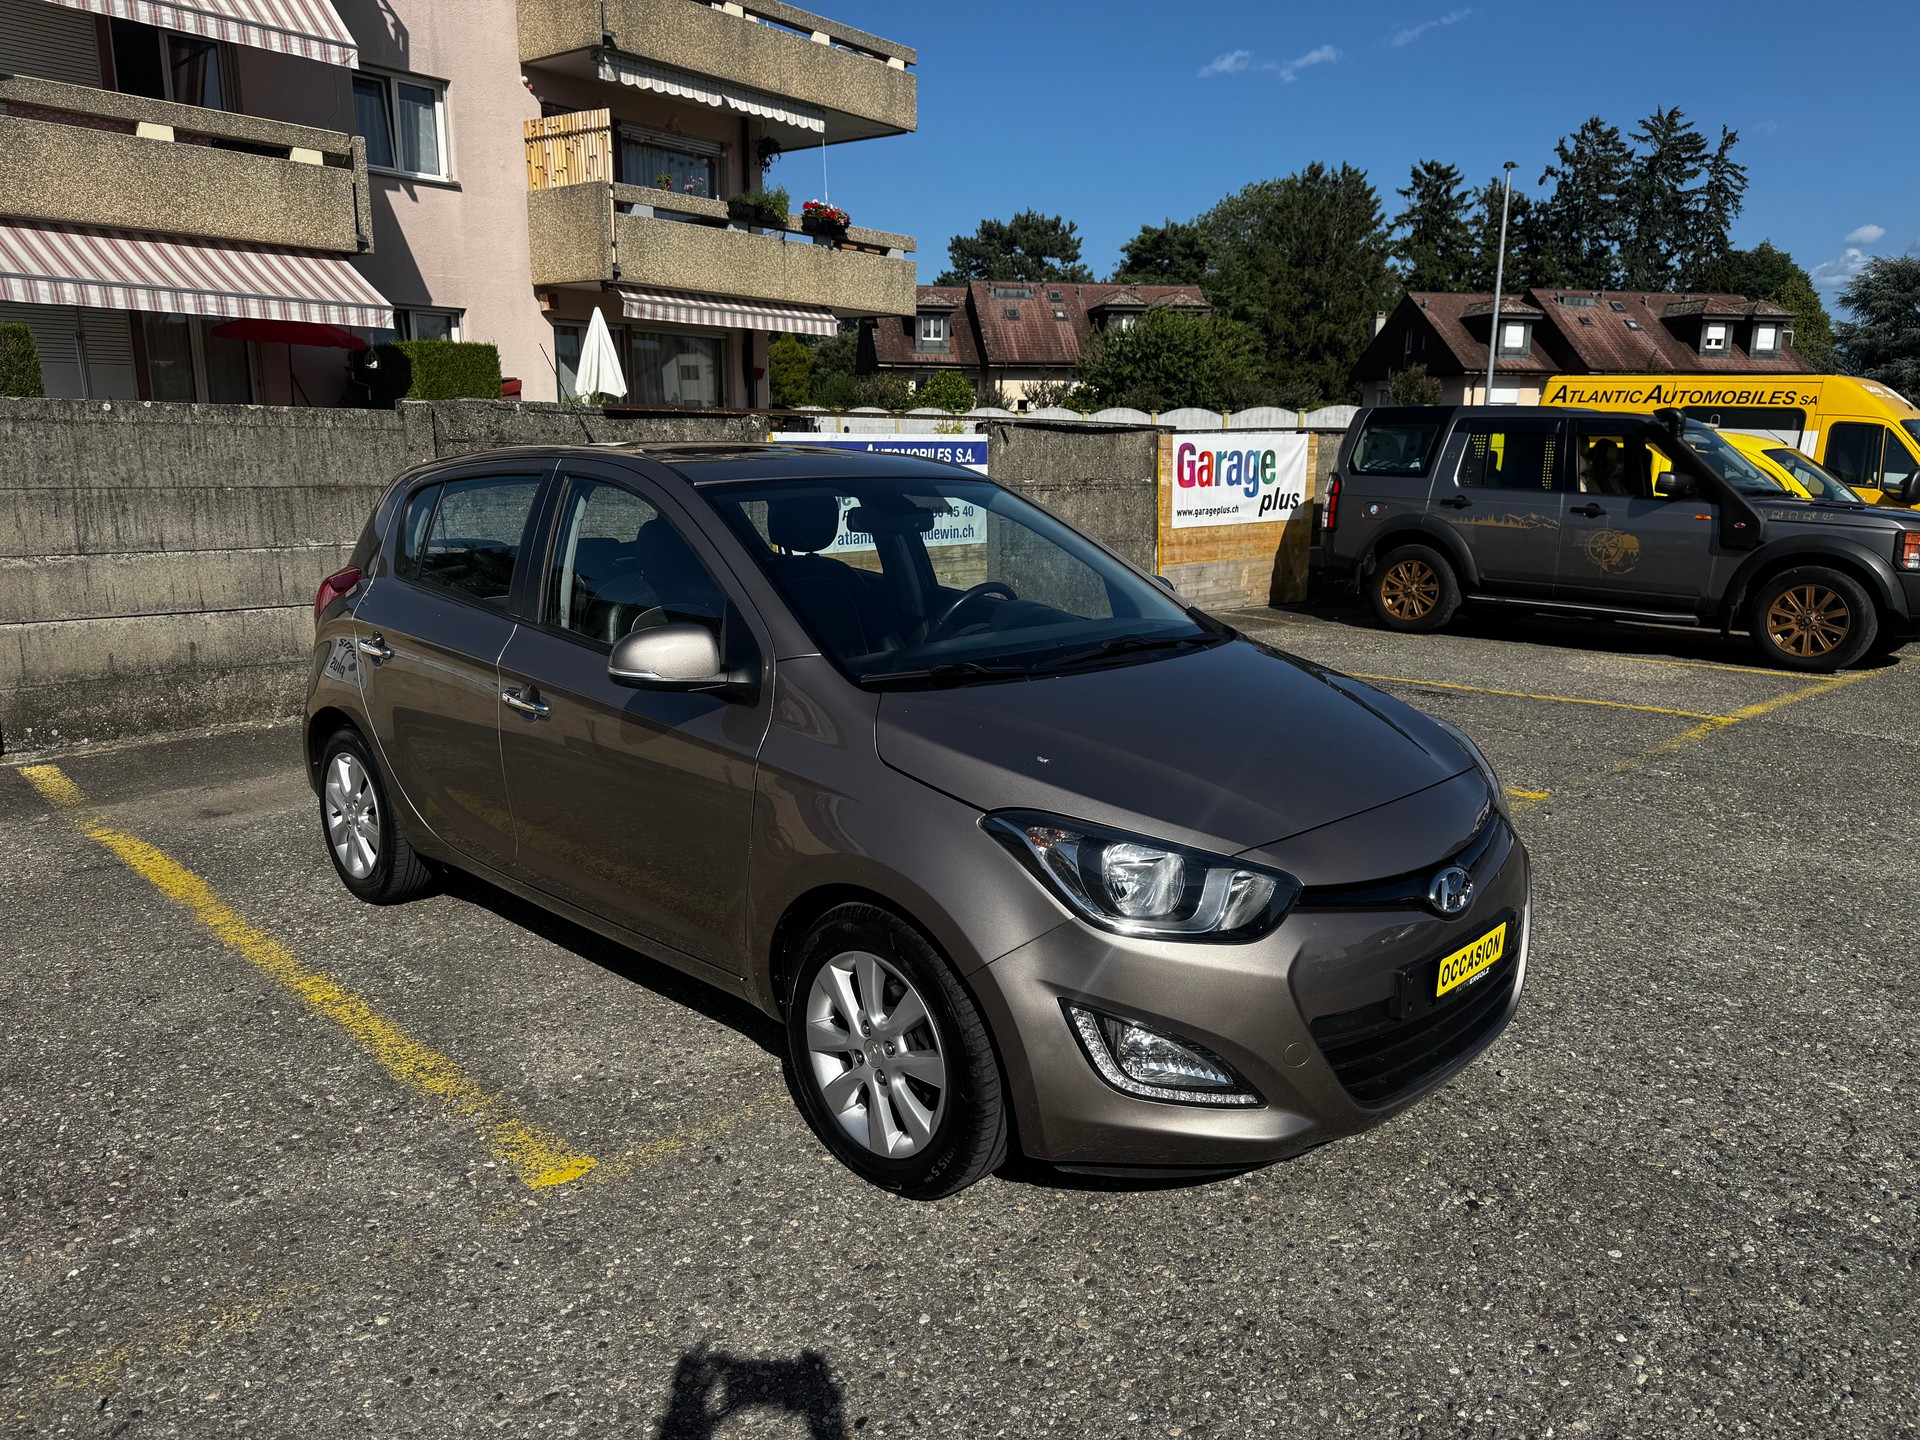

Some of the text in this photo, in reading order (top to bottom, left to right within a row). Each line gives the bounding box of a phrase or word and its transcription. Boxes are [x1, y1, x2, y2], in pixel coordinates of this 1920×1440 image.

[1549, 384, 1818, 406] ATLANTIC AUTOMOBILES SA
[955, 448, 975, 463] S.A.
[1177, 442, 1276, 498] Garage
[962, 505, 974, 517] 40
[1176, 505, 1239, 518] www.garageplus.ch
[1258, 487, 1300, 517] plus
[1441, 931, 1502, 987] OCCASION
